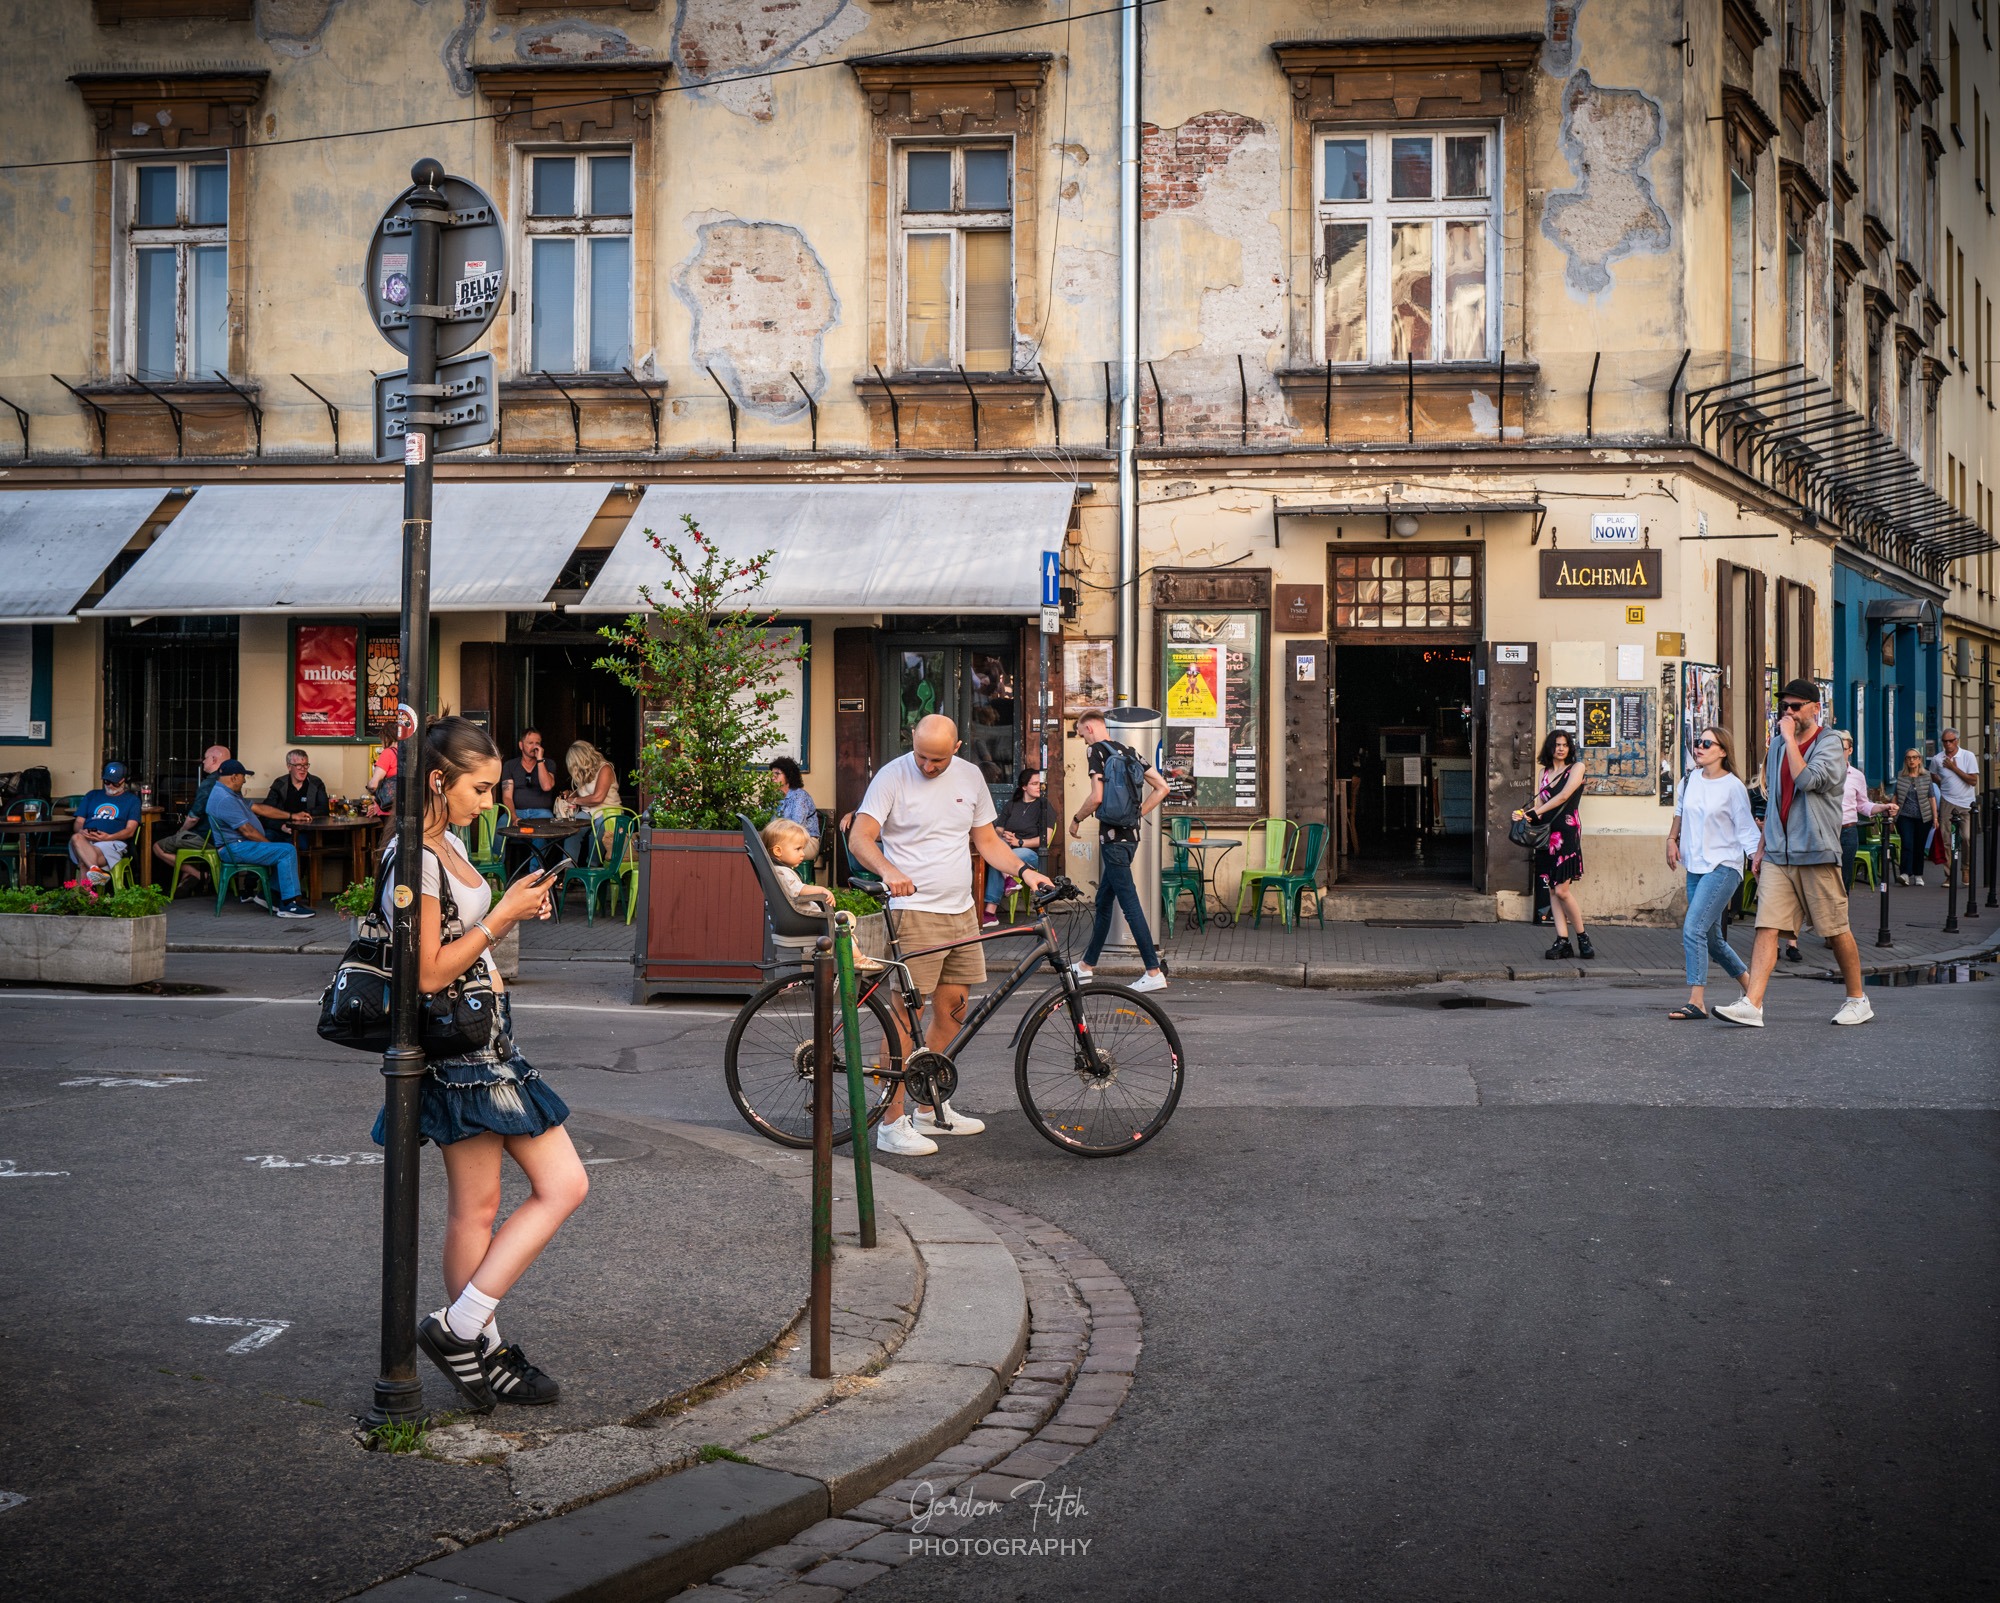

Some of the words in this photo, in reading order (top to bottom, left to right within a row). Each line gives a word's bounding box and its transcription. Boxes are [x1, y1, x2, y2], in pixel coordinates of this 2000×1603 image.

[1595, 526, 1636, 538] NOWY
[1556, 559, 1648, 586] ALCHEMIA
[1172, 623, 1190, 631] HAPPY
[1172, 631, 1191, 639] HOURS
